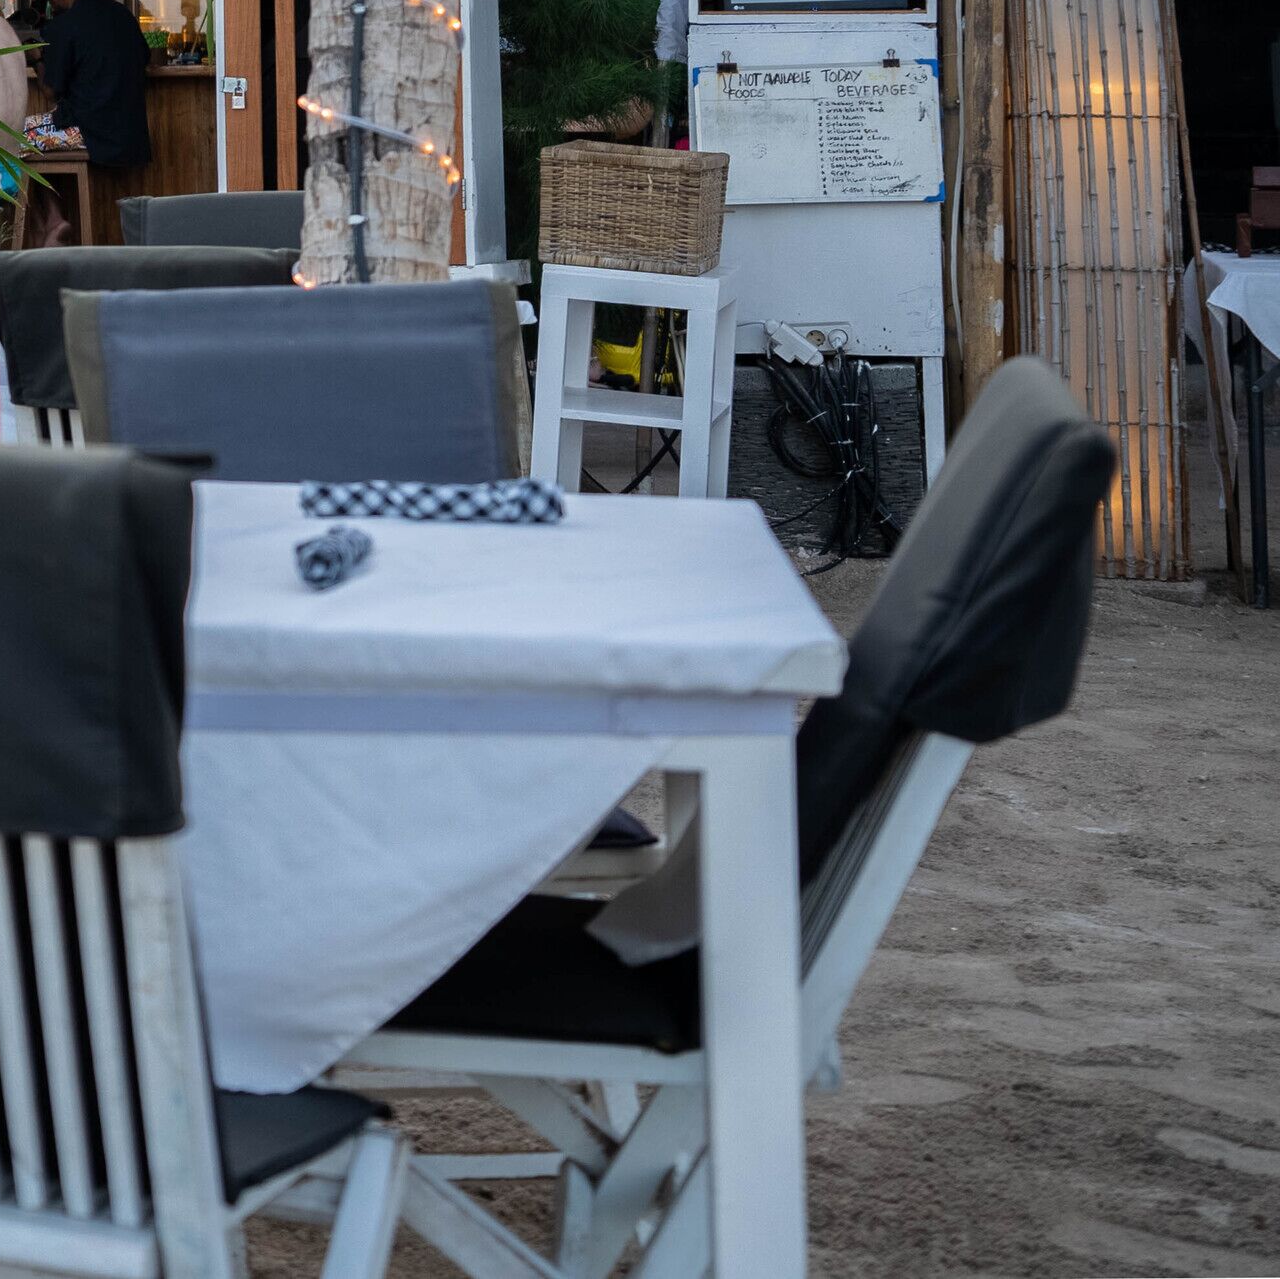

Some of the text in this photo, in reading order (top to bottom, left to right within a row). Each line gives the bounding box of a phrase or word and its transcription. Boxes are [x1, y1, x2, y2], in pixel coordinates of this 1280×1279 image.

[738, 68, 863, 87] NOT AVAILABLE TODAY
